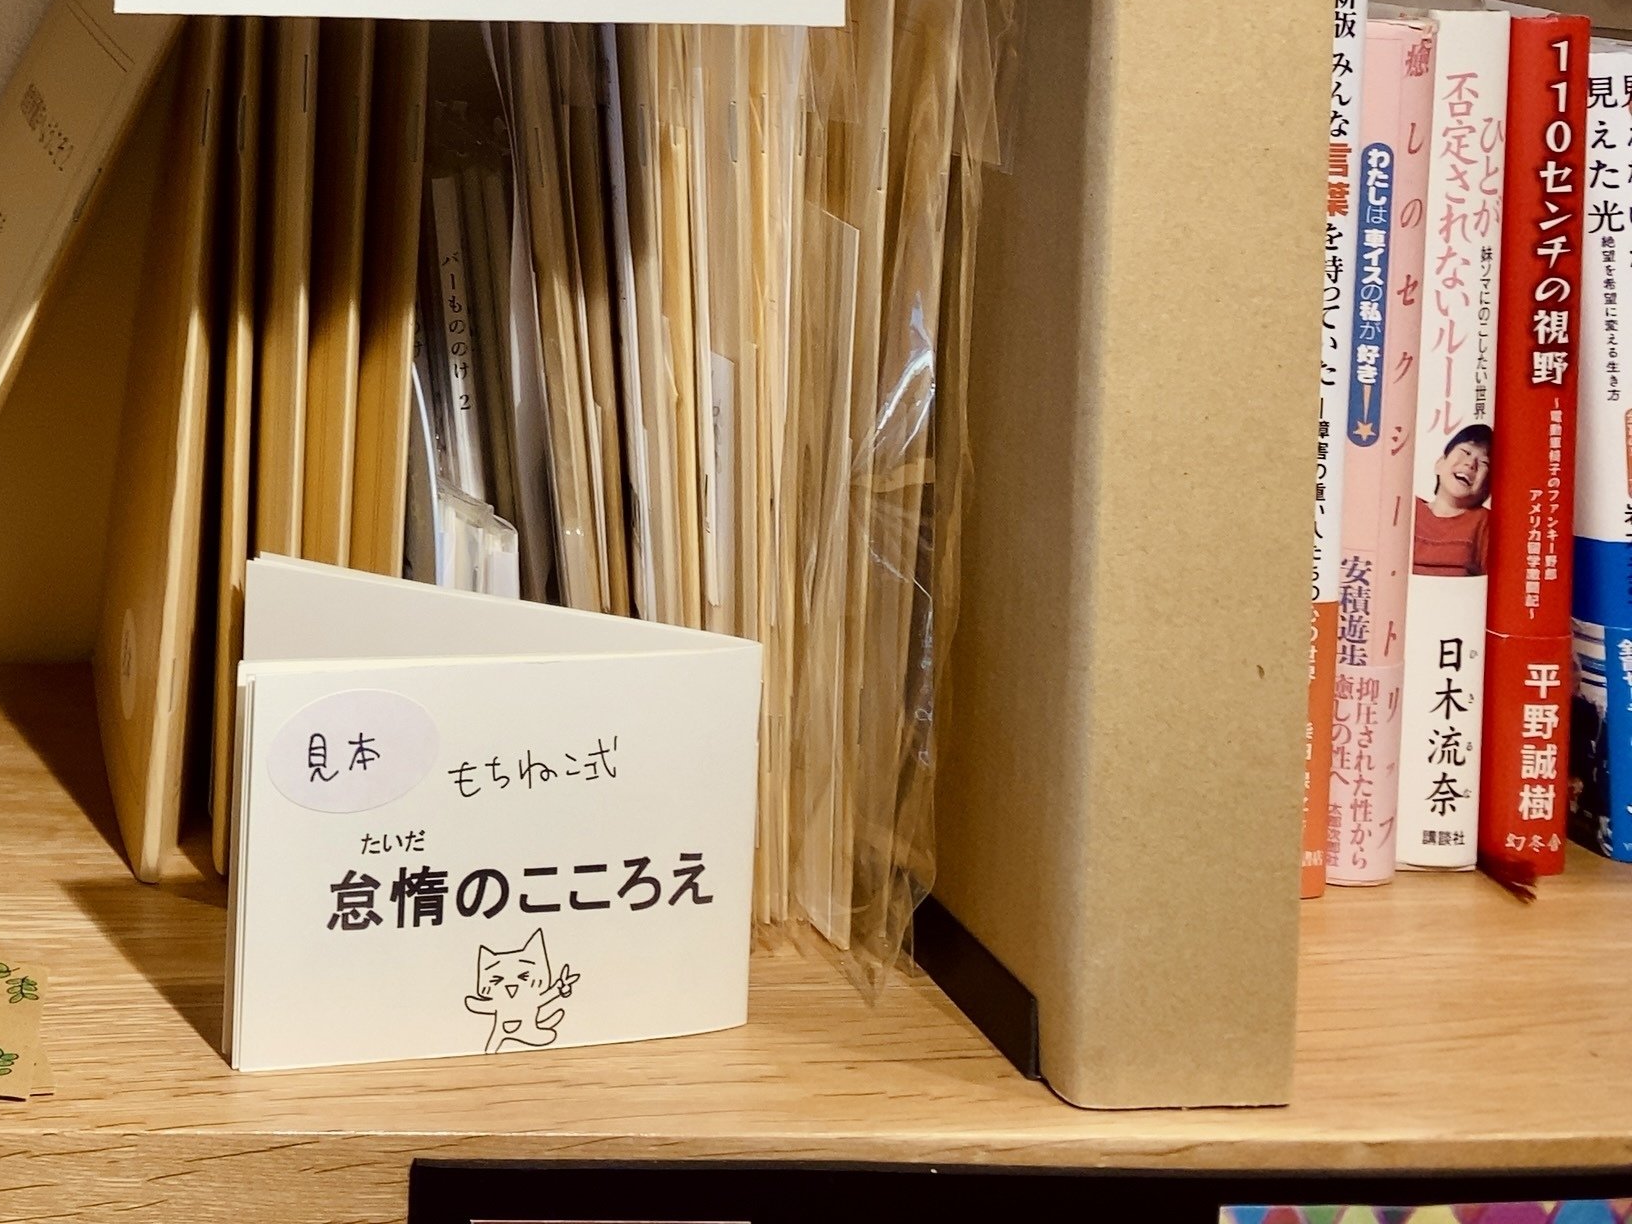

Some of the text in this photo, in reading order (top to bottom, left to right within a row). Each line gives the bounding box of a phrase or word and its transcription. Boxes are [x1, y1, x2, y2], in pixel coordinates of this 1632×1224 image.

[1472, 117, 1506, 238] ひとが
[1532, 40, 1574, 385] 110センチの視野
[1586, 76, 1625, 234] 見えた光
[1430, 72, 1479, 436] 否定されないルール
[459, 394, 471, 411] 2
[1337, 555, 1372, 667] 安積遊歩
[308, 733, 380, 782] 見本
[448, 736, 618, 798] もちねこ式
[1350, 677, 1380, 870] 抑圧された性から
[1425, 638, 1468, 817] 日木流奈
[1518, 663, 1562, 821] 平野誠樹
[326, 852, 714, 930] 怠惰のこころえ
[361, 830, 425, 854] たいだ
